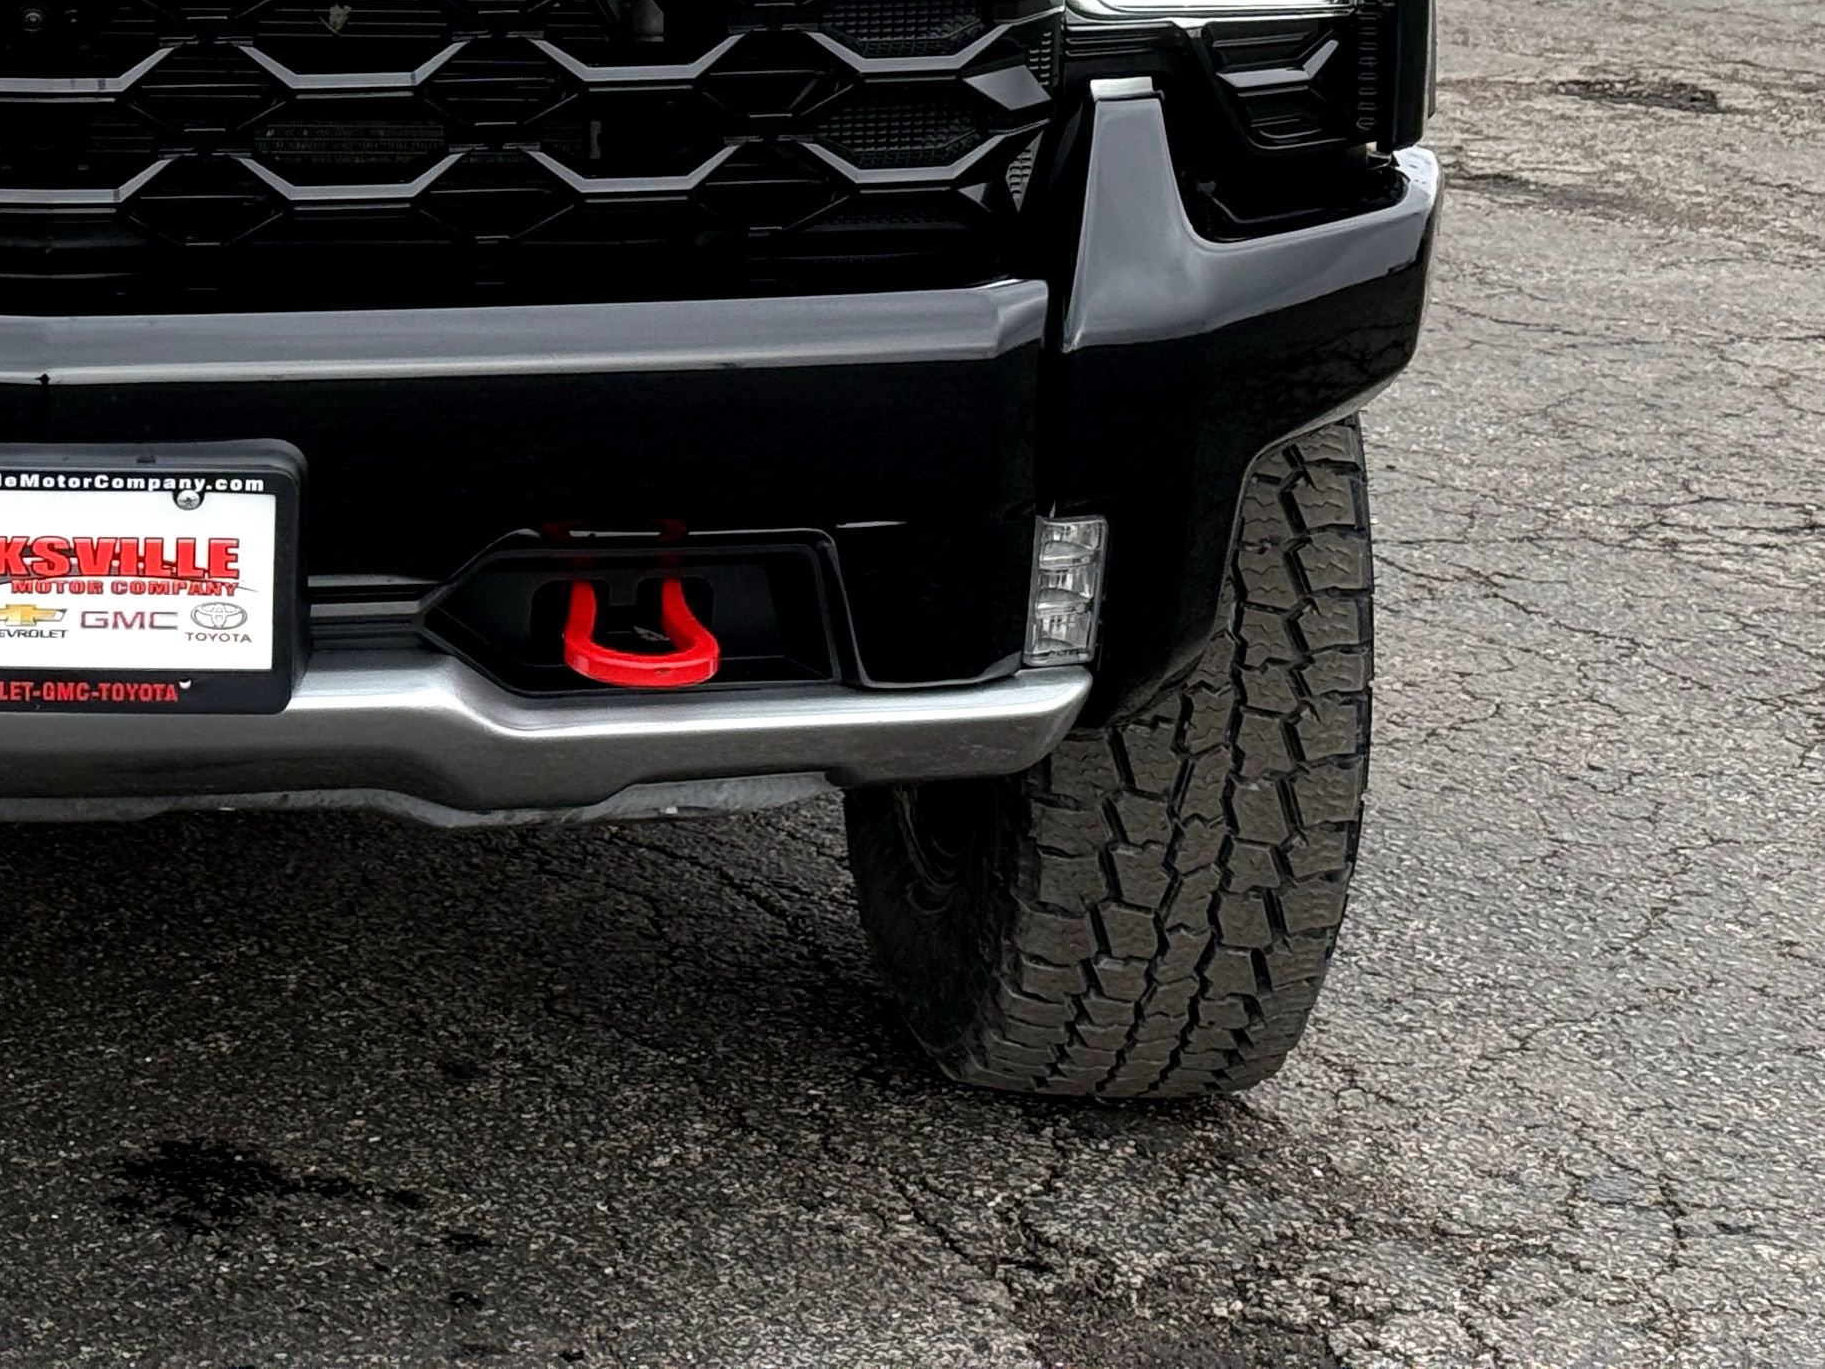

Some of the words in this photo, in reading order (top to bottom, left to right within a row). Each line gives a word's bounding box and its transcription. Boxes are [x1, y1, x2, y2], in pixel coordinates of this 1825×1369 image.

[11, 579, 104, 595] MOTOR
[110, 580, 240, 597] COMPANY
[80, 610, 178, 630] GMC
[184, 631, 252, 643] TOYOTA
